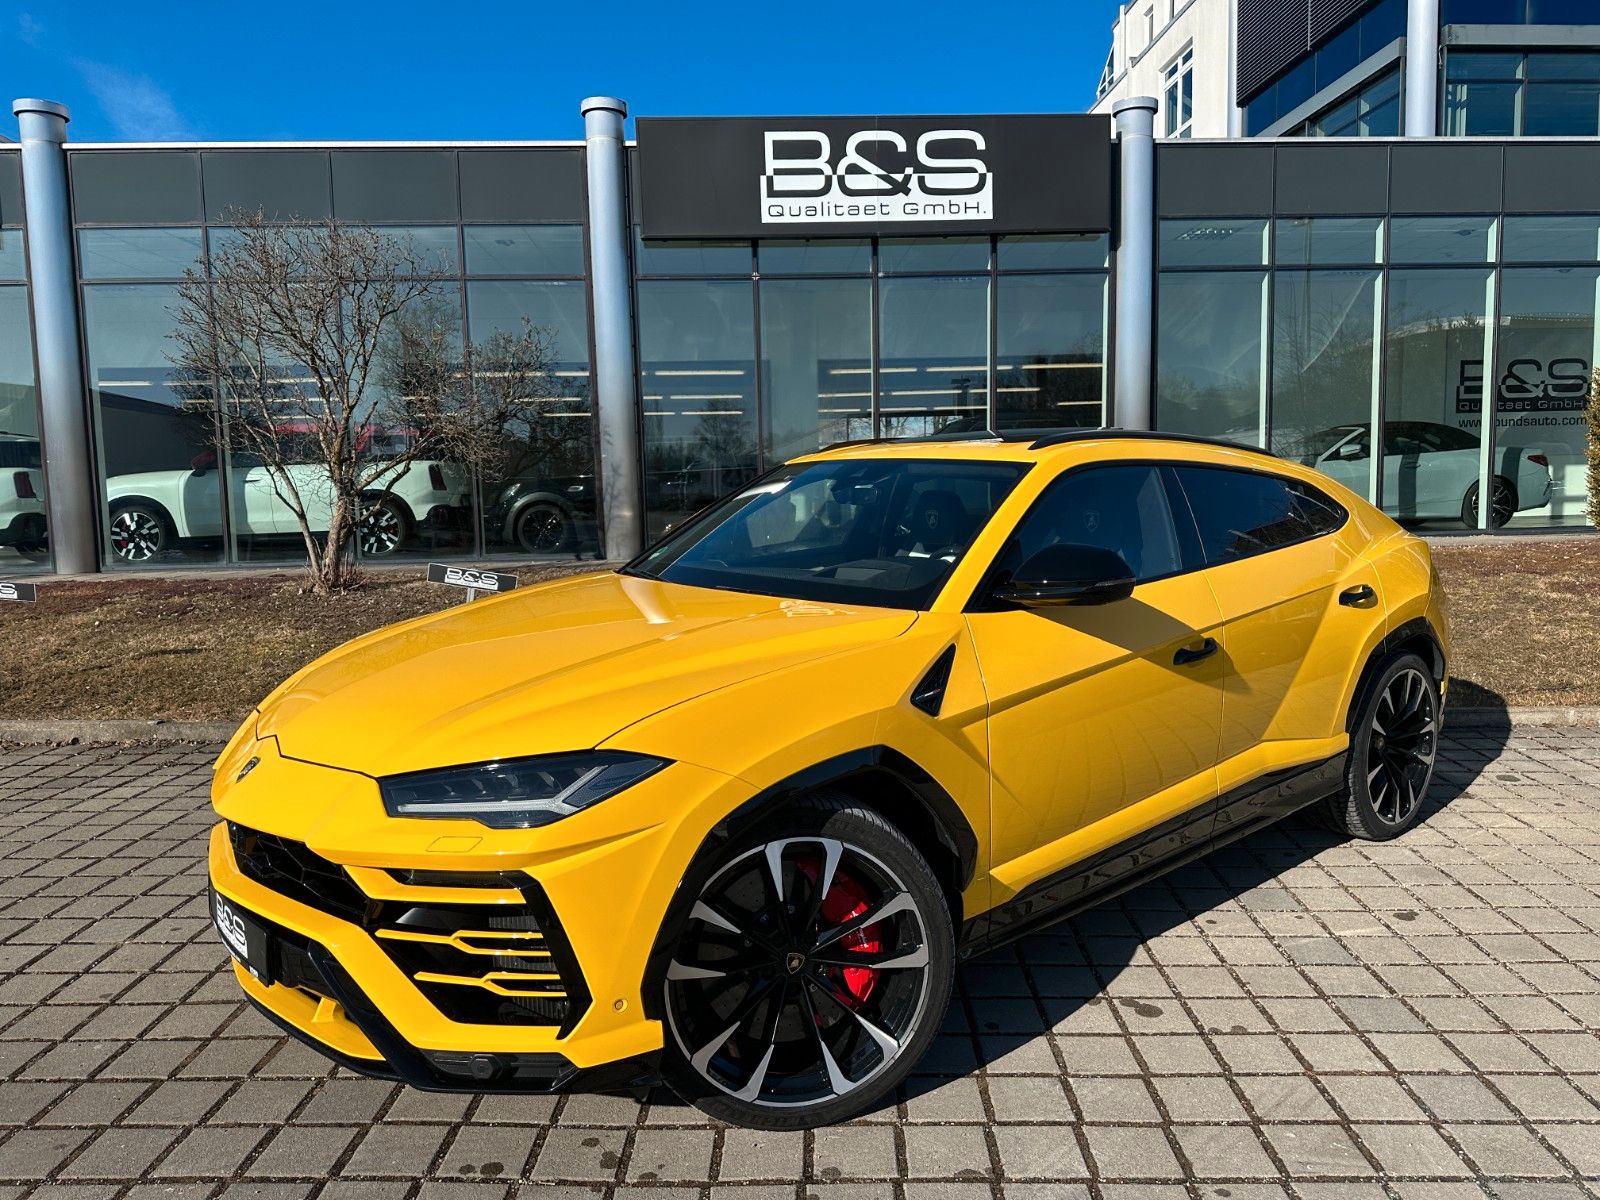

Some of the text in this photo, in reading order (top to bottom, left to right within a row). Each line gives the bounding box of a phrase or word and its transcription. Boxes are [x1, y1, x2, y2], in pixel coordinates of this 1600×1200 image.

[764, 129, 988, 198] B&S
[768, 199, 987, 217] Qualitaet GmbH.
[1459, 400, 1531, 411] Qutaet
[446, 568, 498, 586] B&S
[216, 893, 247, 947] B&S
